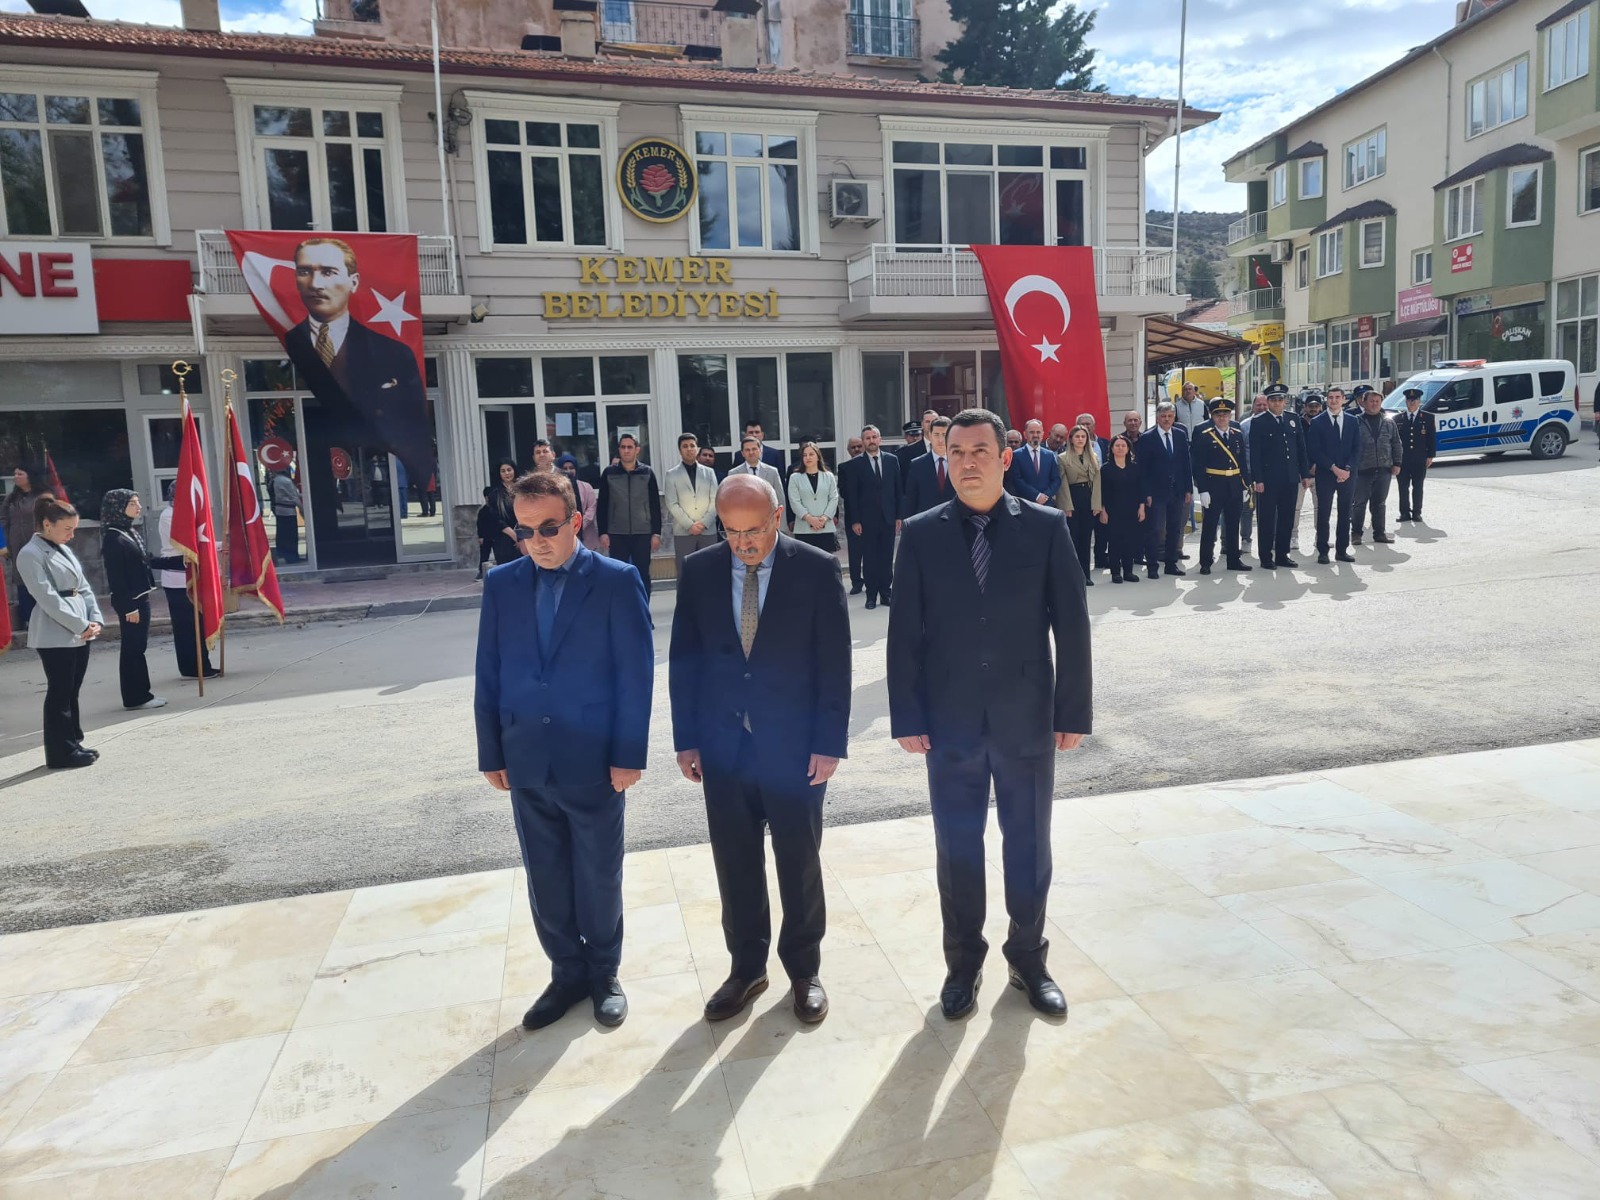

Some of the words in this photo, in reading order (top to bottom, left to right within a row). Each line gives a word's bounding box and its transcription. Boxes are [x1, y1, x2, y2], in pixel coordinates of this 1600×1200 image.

[633, 147, 676, 161] KEMER
[578, 257, 733, 284] KEMER
[541, 287, 780, 318] BELEDİYESİ
[1439, 414, 1479, 431] POLİS
